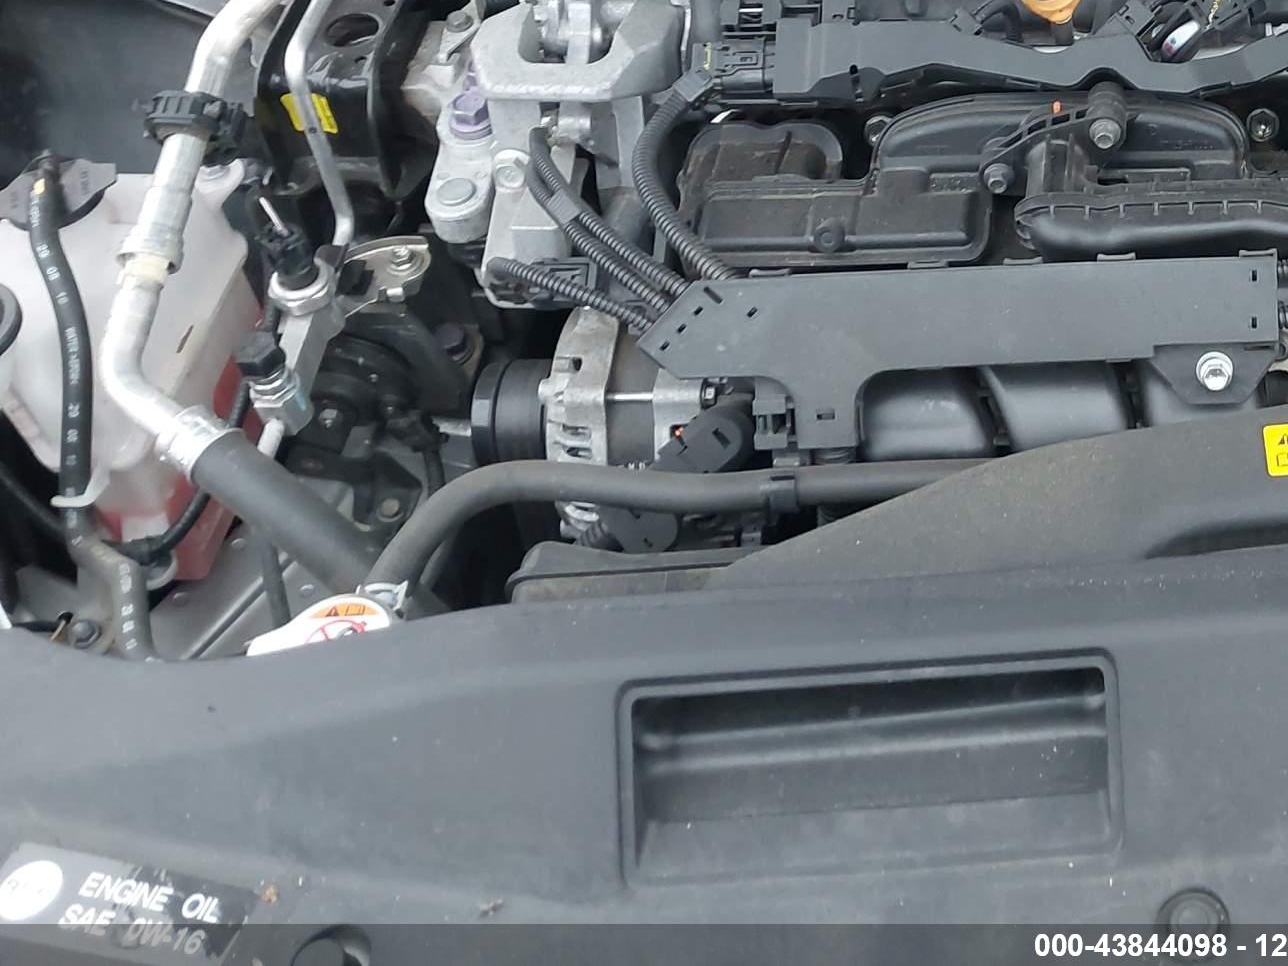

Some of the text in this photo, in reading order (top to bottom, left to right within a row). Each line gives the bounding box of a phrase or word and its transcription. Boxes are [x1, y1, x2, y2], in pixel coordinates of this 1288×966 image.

[78, 871, 174, 912] ENGINE
[181, 892, 221, 924] OIL
[58, 902, 206, 955] SAE 0W-16
